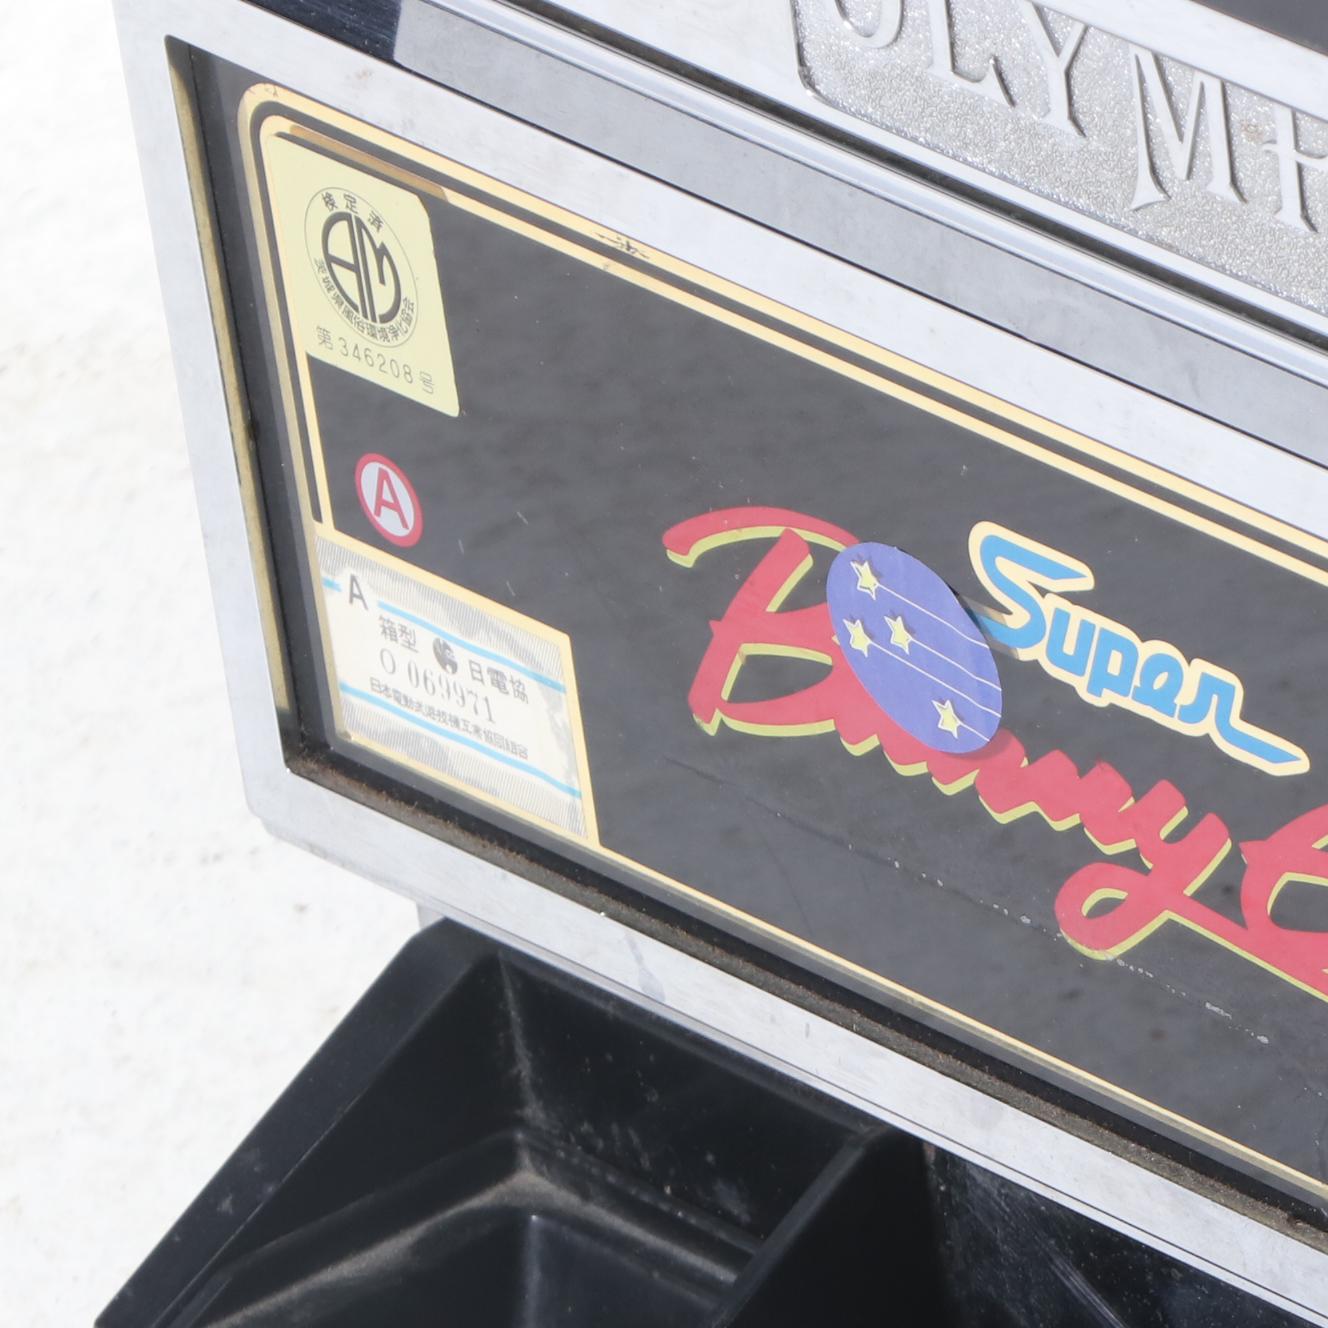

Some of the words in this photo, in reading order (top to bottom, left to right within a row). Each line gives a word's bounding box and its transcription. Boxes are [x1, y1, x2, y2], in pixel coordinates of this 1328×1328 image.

[315, 325, 435, 395] 第346208号
[372, 463, 410, 531] A
[348, 573, 370, 612] A
[968, 520, 1311, 776] Super
